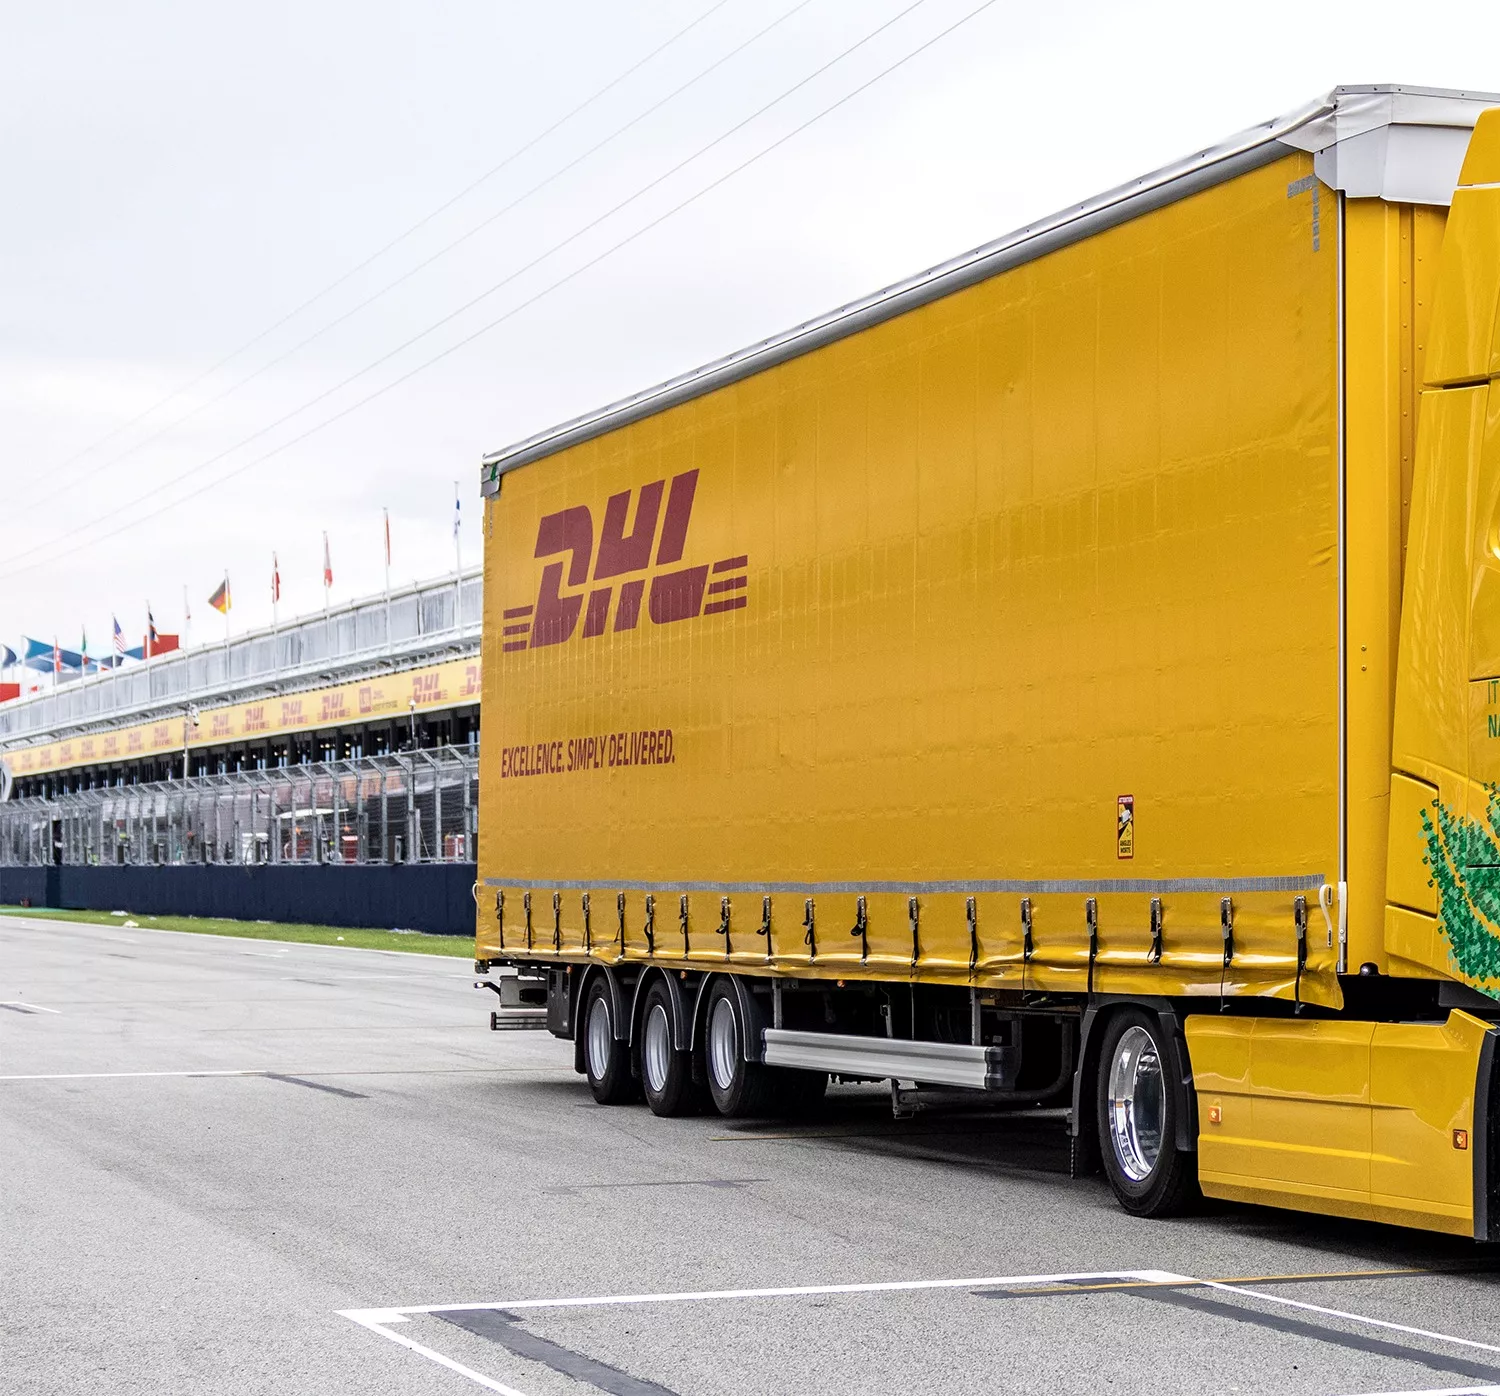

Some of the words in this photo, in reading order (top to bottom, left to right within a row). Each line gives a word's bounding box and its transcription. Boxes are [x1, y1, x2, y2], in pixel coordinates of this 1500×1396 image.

[529, 468, 710, 650] DHL
[322, 693, 345, 720] DHL
[412, 673, 441, 704] DHL
[501, 740, 565, 778] EXCELLENCE.
[567, 735, 608, 771] SIMPLY
[608, 729, 675, 767] DELIVERED.
